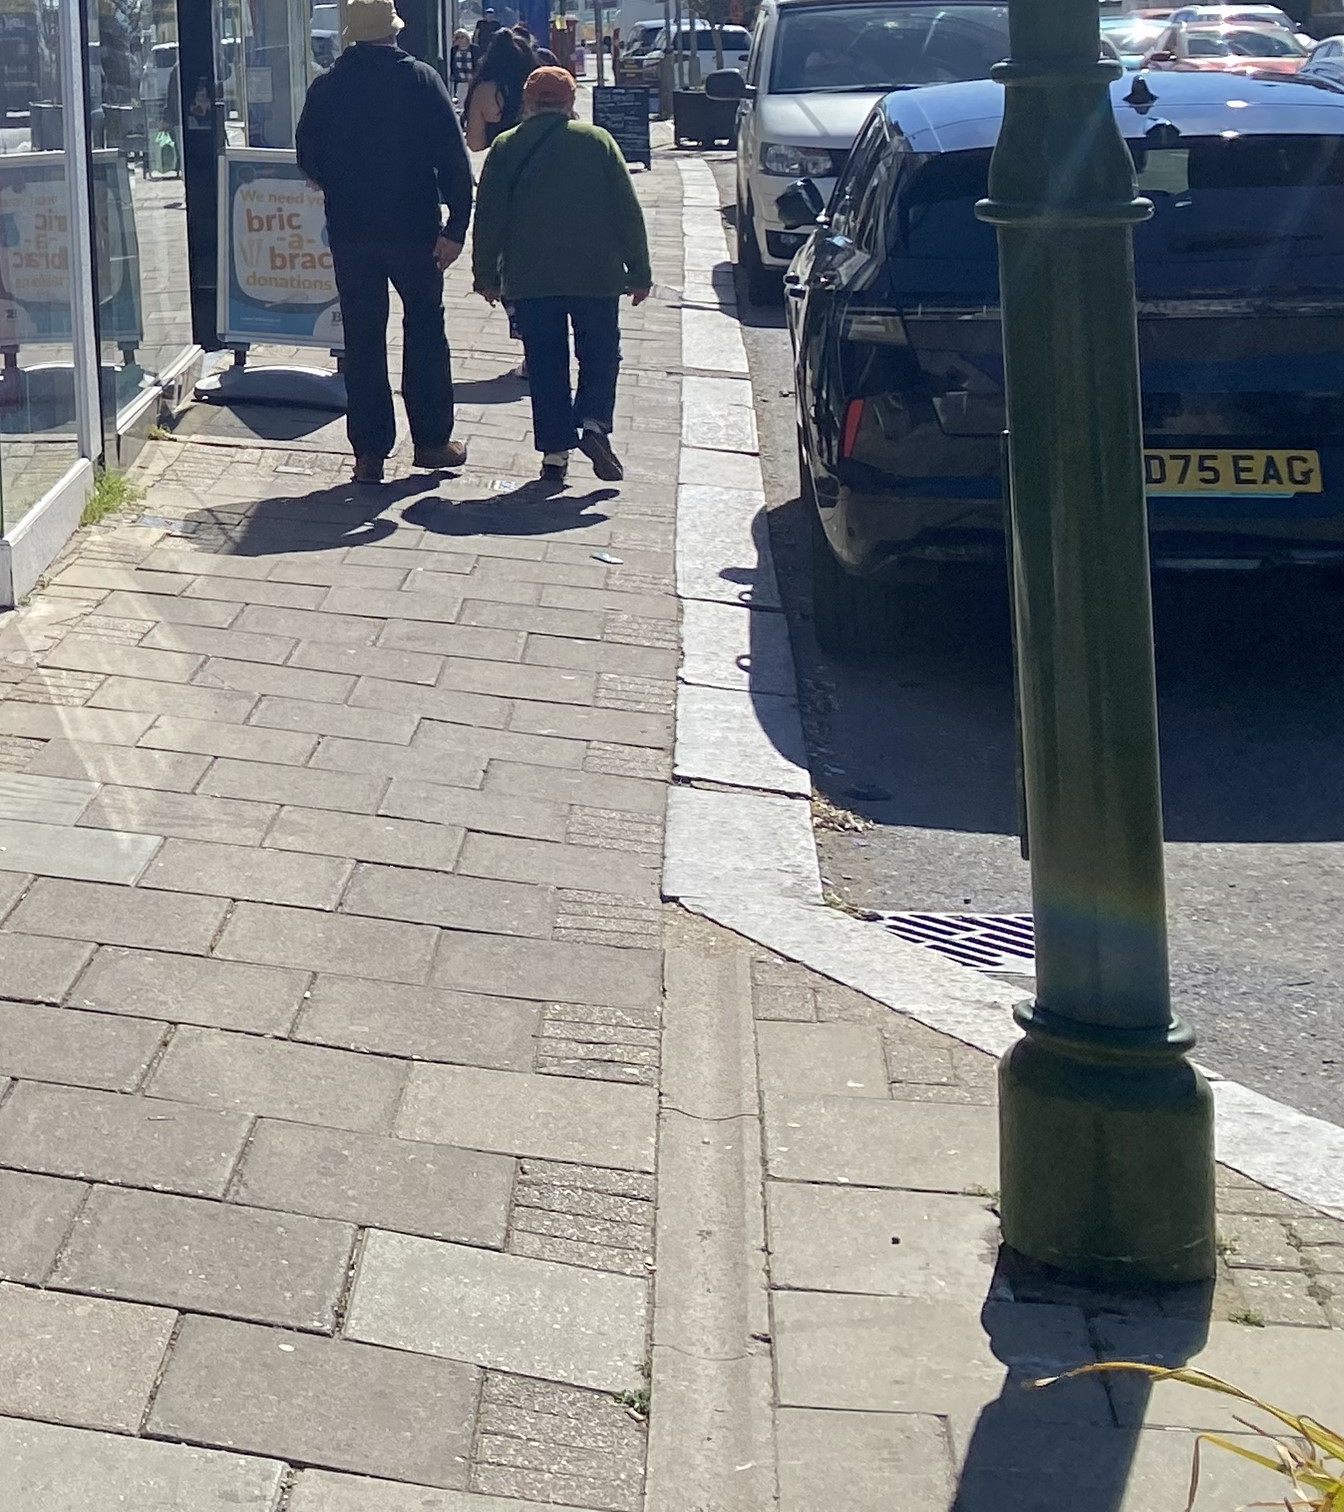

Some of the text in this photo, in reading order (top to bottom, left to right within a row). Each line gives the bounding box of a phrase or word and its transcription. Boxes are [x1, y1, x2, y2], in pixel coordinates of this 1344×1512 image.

[240, 189, 265, 202] We
[268, 191, 305, 205] need
[245, 207, 303, 233] bric
[269, 246, 333, 271] brac
[246, 271, 332, 291] donations
[1144, 454, 1314, 486] D75 EAG
